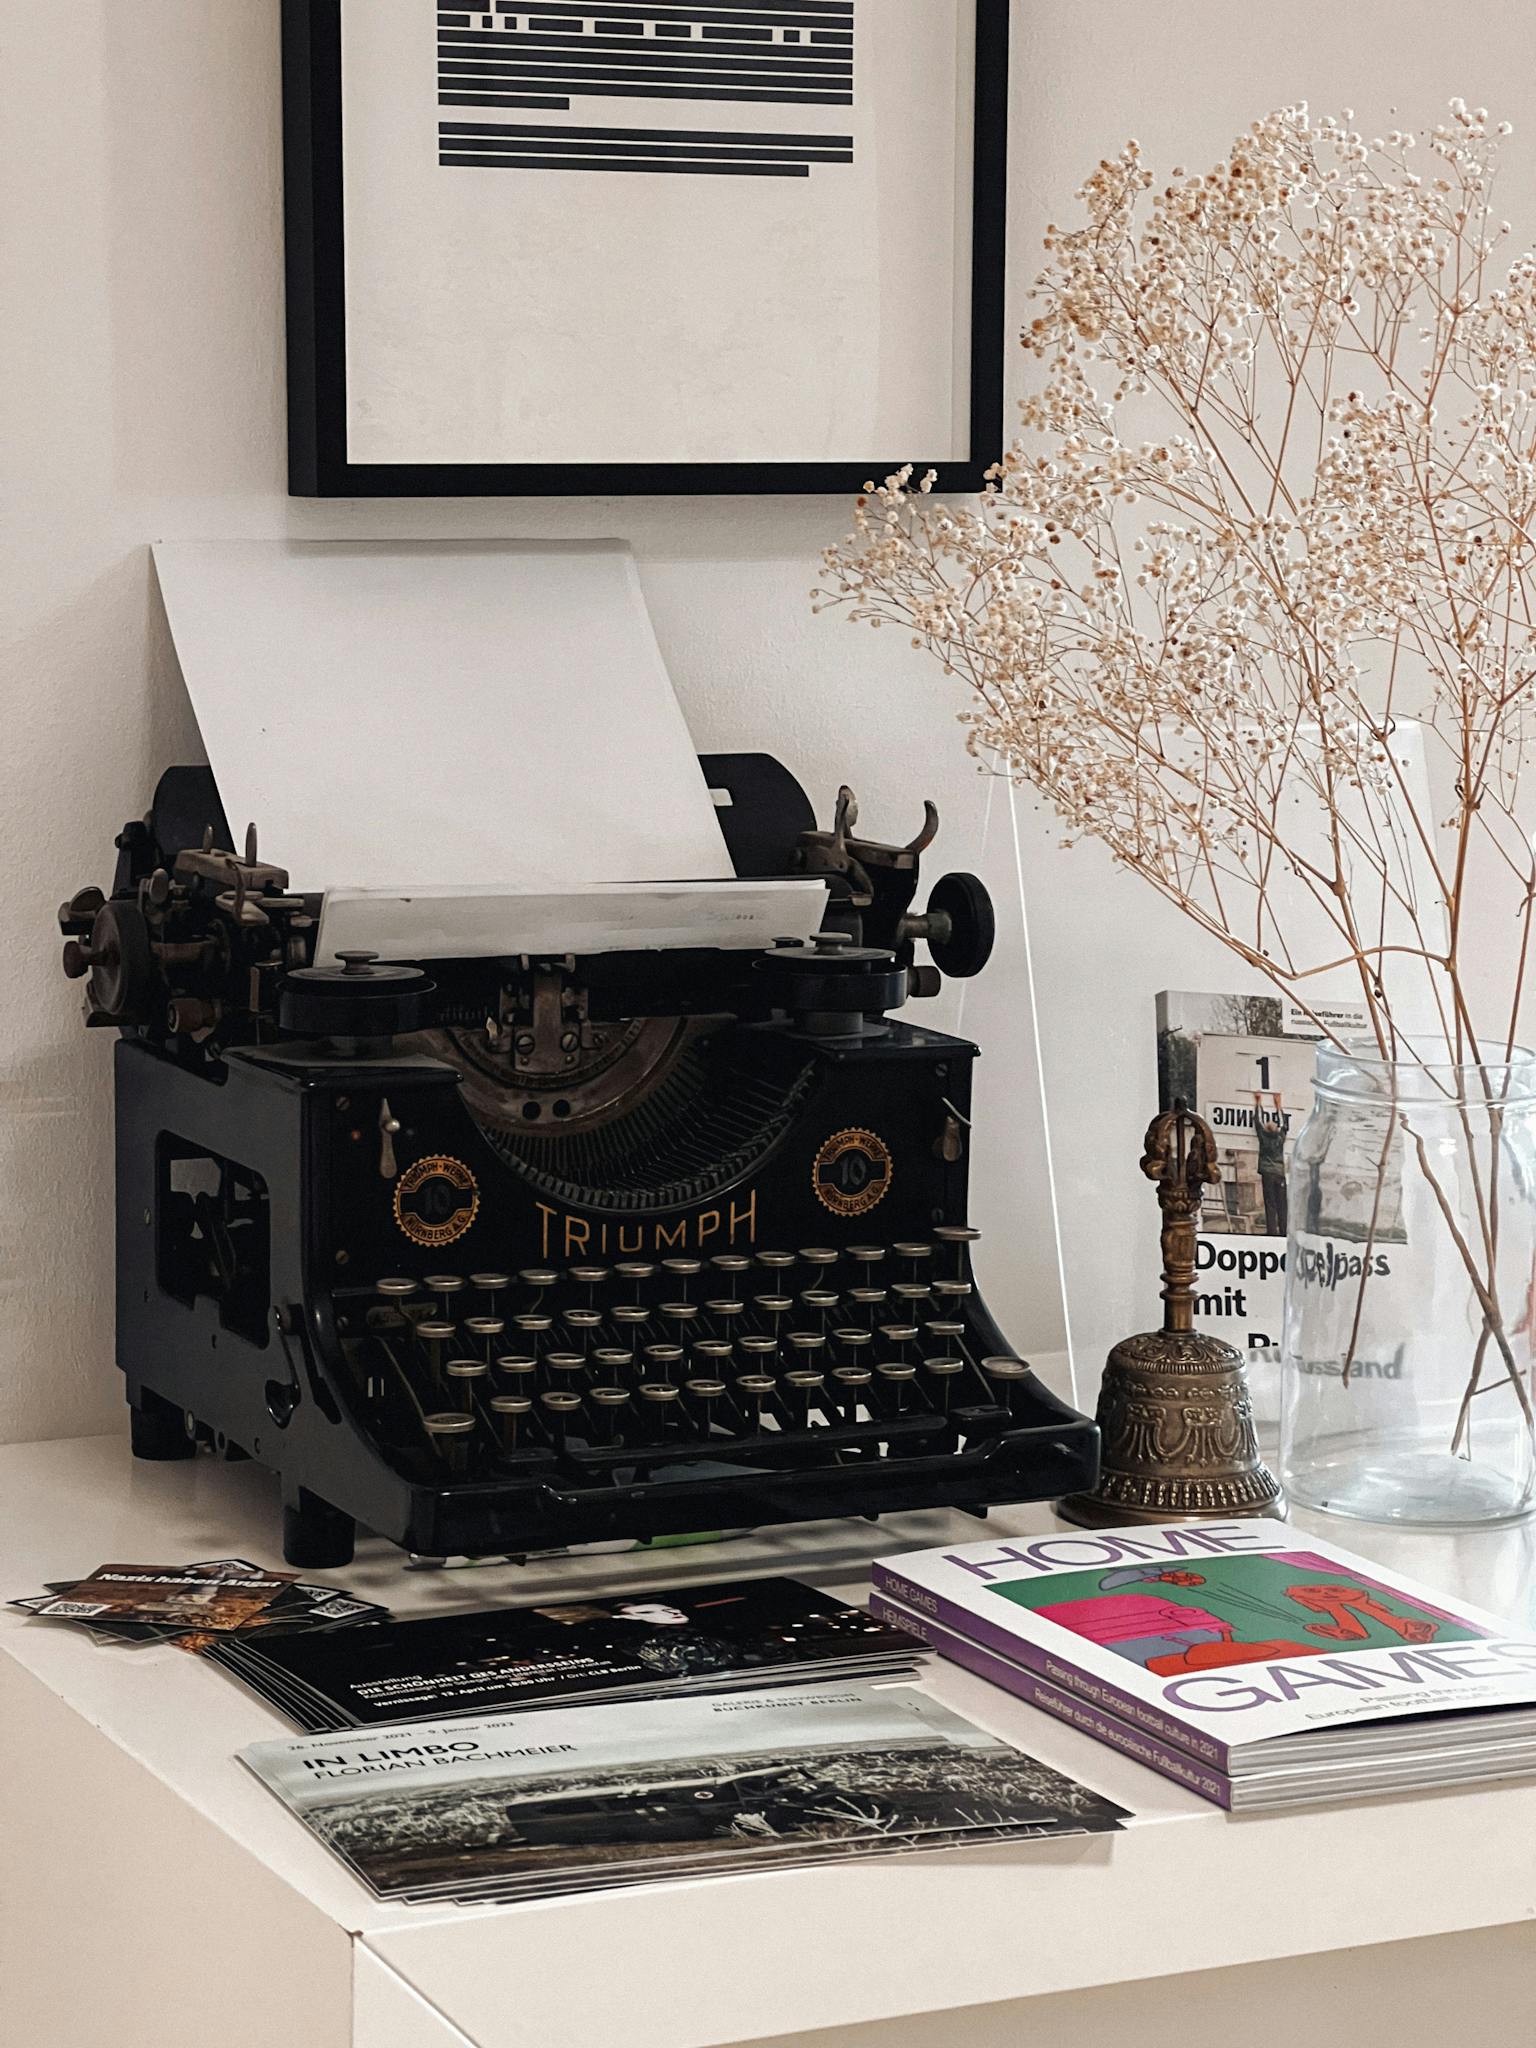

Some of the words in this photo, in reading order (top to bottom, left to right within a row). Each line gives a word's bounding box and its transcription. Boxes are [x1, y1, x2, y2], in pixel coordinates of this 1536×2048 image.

[1255, 1056, 1269, 1090] 1
[535, 1188, 756, 1260] TRIUMPH
[1193, 1286, 1247, 1317] mit
[941, 1526, 1287, 1580] HOME
[96, 1573, 154, 1584] Nazis
[154, 1575, 220, 1586] haben
[350, 1674, 423, 1690] Ausstellung
[357, 1686, 384, 1695] DIE
[499, 1656, 595, 1675] ANDERSSEINS
[459, 1685, 487, 1696] April
[536, 1675, 556, 1684] Uhr
[608, 1664, 643, 1675] Berlin
[302, 1756, 348, 1770] IN
[358, 1740, 480, 1764] LIMBO
[313, 1758, 427, 1780] FLORIAN
[432, 1743, 579, 1766] BACHMEIER
